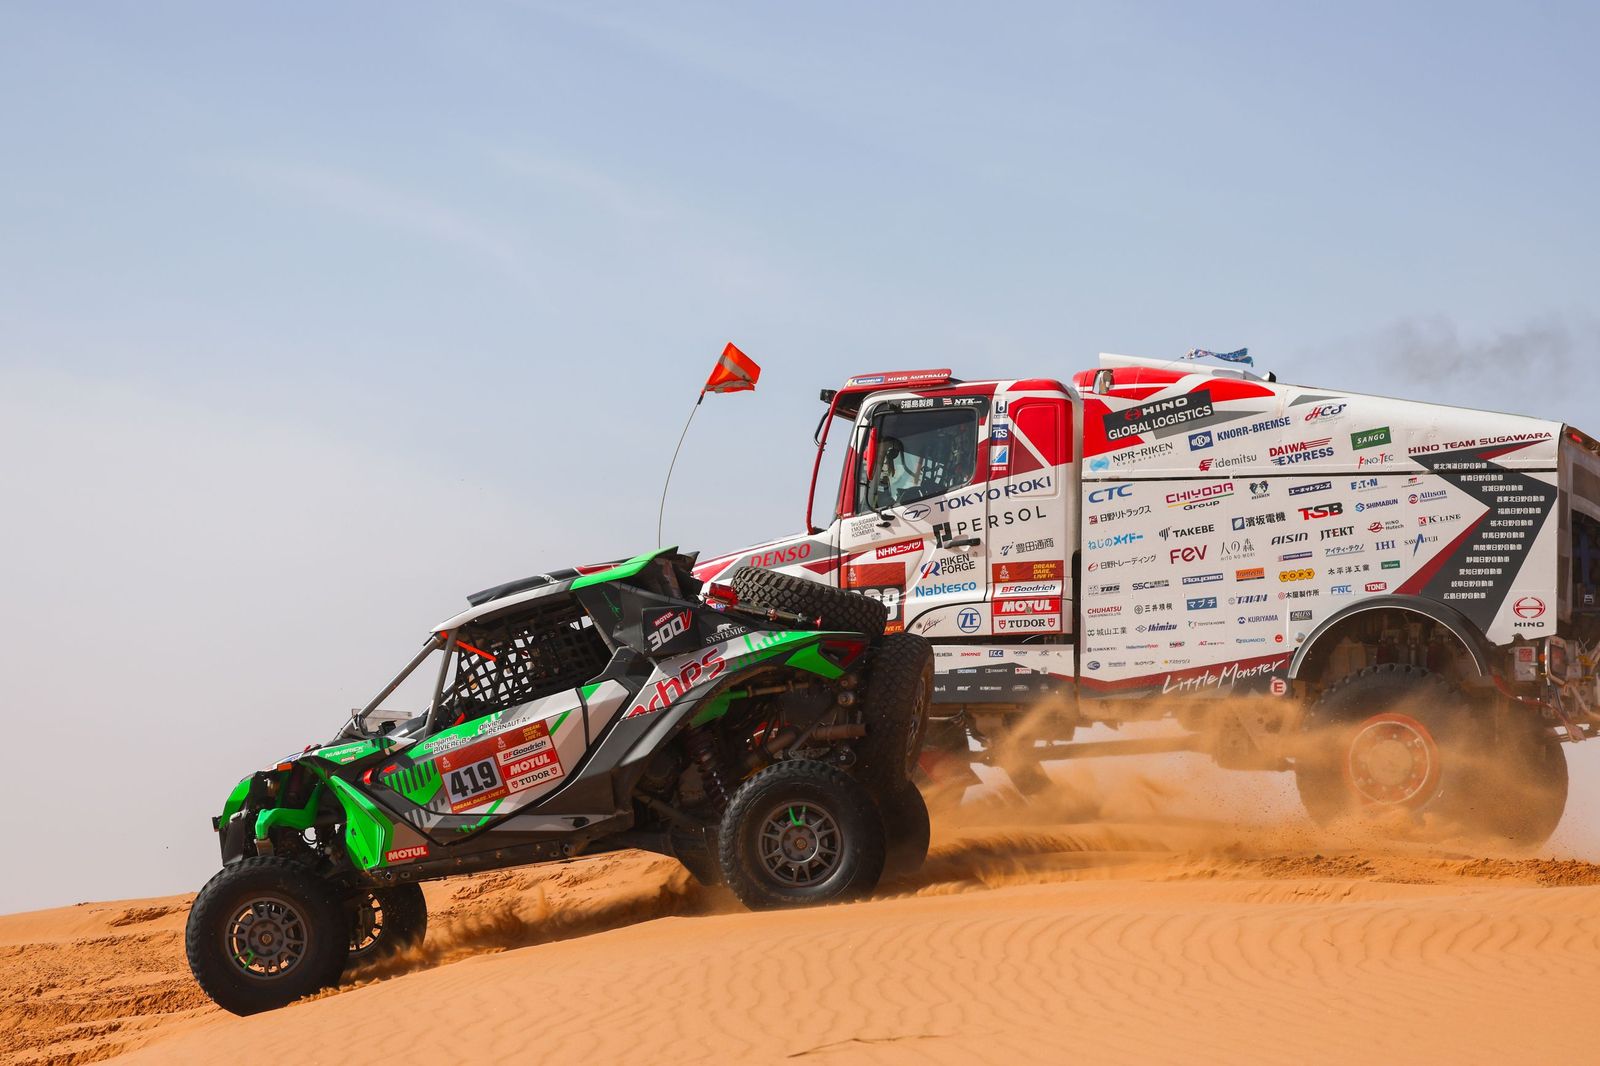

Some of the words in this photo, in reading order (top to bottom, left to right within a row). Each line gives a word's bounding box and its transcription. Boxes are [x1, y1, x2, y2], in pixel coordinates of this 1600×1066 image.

[954, 398, 975, 406] NYK
[1142, 397, 1188, 416] HINO
[1108, 420, 1151, 440] GLOBAL
[1152, 405, 1212, 428] LOGISTICS
[1217, 416, 1291, 441] KNORR-BREMSE
[1357, 433, 1385, 444] SANGO
[1408, 444, 1440, 454] HINO
[1442, 440, 1476, 450] TEAM
[1480, 432, 1552, 445] SUGAWARA
[1112, 442, 1173, 463] NPR-RIKEN
[1269, 441, 1307, 457] DAIWA
[1279, 447, 1334, 466] EXPRESS
[1215, 453, 1257, 468] idemitsu
[935, 488, 1000, 512] TOKYO
[1004, 476, 1051, 496] ROKI
[1088, 483, 1133, 504] CTC
[1166, 482, 1234, 504] CHIYODA
[1420, 490, 1446, 498] Allison
[1183, 500, 1220, 510] Group
[1298, 502, 1343, 520] TSB
[957, 506, 1046, 534] PERSOL
[1100, 505, 1152, 522] 日野リトラックス
[1440, 514, 1461, 522] LINE
[1173, 524, 1215, 538] TAKEBE
[1271, 532, 1308, 545] AISIN
[1320, 526, 1354, 540] JTEKT
[1376, 540, 1396, 550] IHI
[750, 544, 812, 567] DENSO
[940, 554, 970, 566] RIKEN
[1100, 554, 1156, 570] 日野トレーディング
[942, 561, 976, 575] FORGE
[1281, 570, 1312, 580] TOPY
[916, 582, 976, 597] Nabtesco
[1002, 584, 1056, 592] BFGoodrich
[1001, 600, 1052, 612] MOTUL
[1088, 606, 1122, 614] CHUHATSU
[1188, 598, 1216, 608] マブチ
[655, 612, 674, 626] MOTUL
[958, 613, 980, 628] ZF
[1008, 619, 1046, 628] TUDOR
[648, 608, 692, 652] 300V
[706, 626, 746, 644] SYSTEMIC
[1163, 670, 1218, 692] Little
[1218, 660, 1285, 688] Monster
[479, 718, 502, 731] Olivier
[424, 734, 458, 750] Benjamin
[503, 740, 546, 760] BFGoodrich
[510, 754, 550, 776] MOTUL
[450, 761, 498, 798] 419
[519, 770, 550, 786] TUDOR
[388, 846, 427, 861] MOTUL
